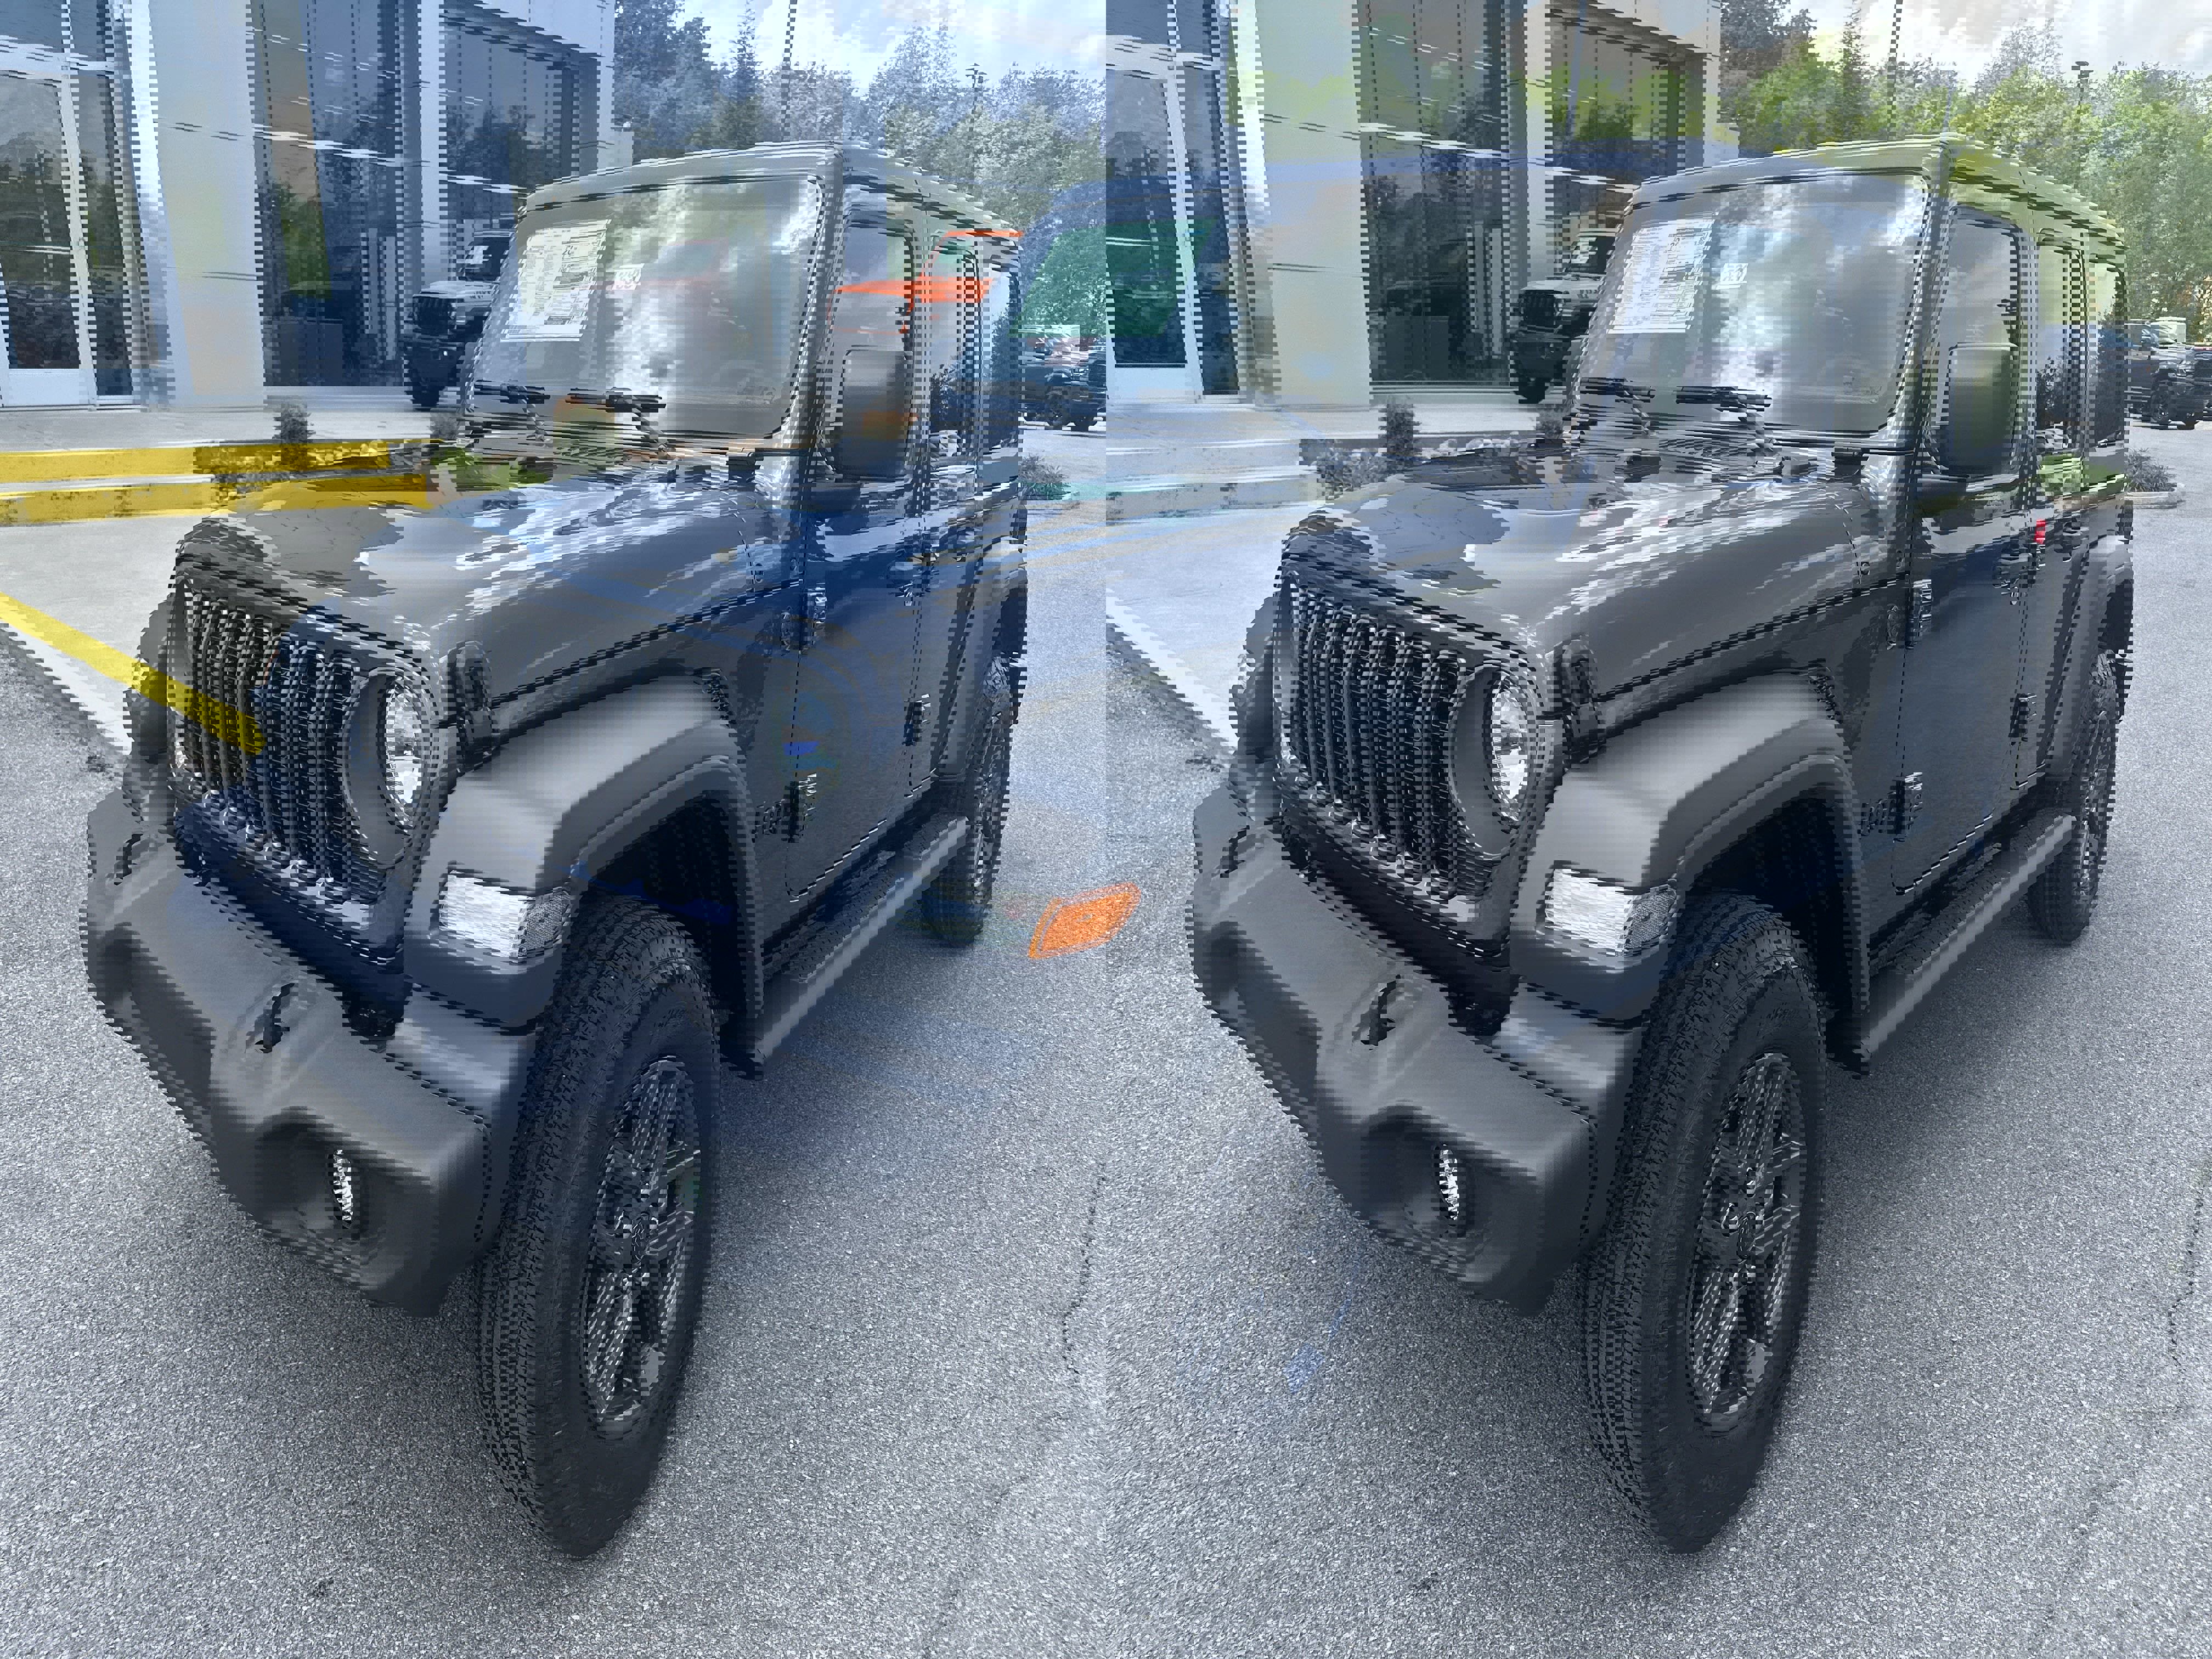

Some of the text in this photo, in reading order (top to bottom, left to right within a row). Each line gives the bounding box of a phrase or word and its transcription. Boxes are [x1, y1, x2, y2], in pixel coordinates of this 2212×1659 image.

[1132, 242, 1145, 251] 20
[944, 290, 975, 299] WILLYS
[1506, 795, 1573, 841] Jeep
